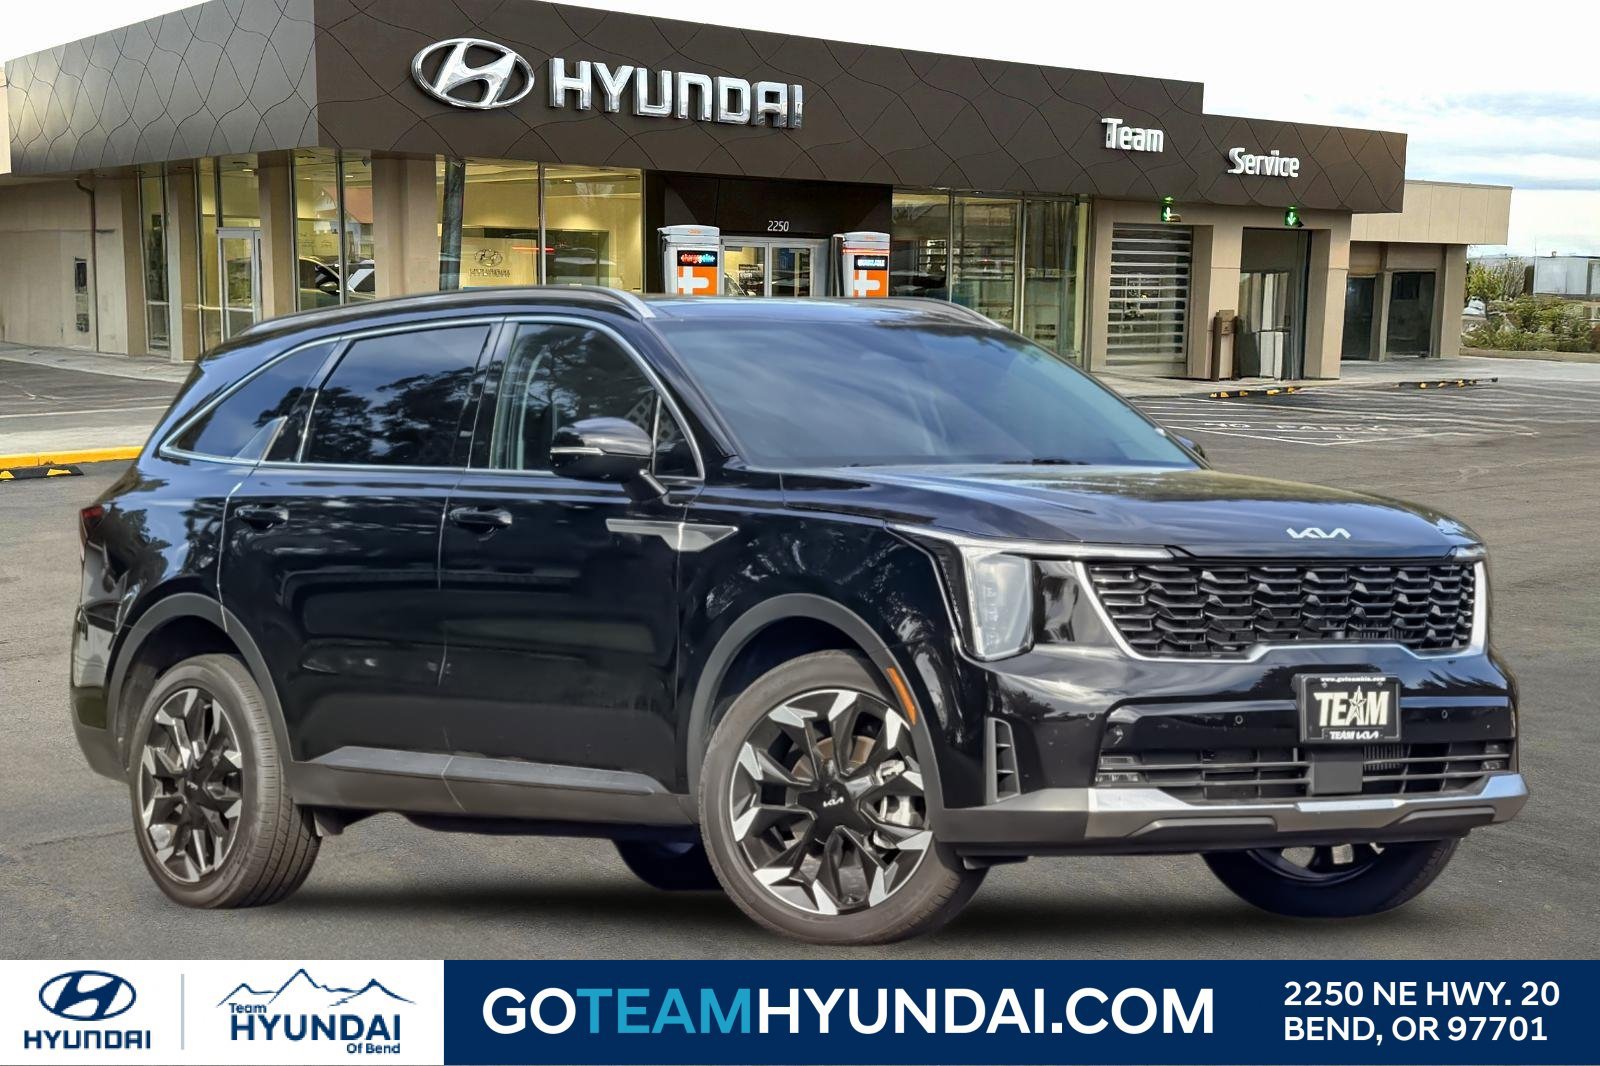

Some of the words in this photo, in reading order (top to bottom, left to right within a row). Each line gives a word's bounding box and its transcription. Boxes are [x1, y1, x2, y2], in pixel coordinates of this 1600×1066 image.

[549, 57, 803, 128] HYUNDAI
[1102, 118, 1164, 152] Team
[1227, 147, 1300, 177] Service
[767, 220, 790, 232] 2250
[1313, 686, 1390, 727] TEAM
[1329, 731, 1356, 740] TEAM
